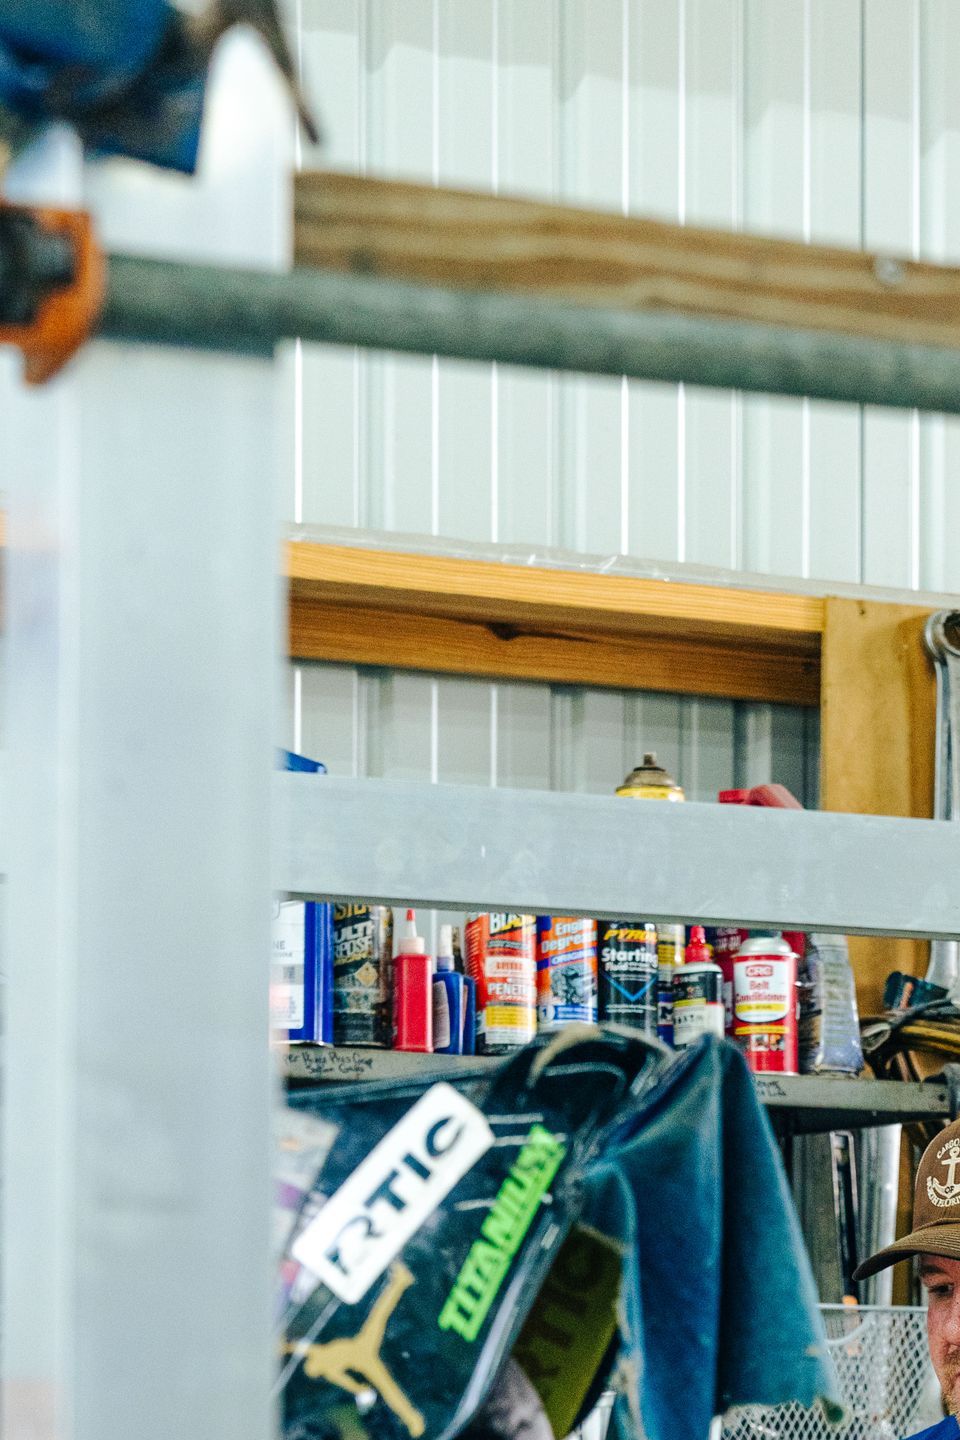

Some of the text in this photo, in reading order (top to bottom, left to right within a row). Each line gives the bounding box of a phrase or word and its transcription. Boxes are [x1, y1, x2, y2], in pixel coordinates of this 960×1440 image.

[602, 947, 659, 968] Starting
[746, 966, 773, 976] CRC
[750, 981, 769, 990] Belt
[736, 992, 787, 1003] Conditioner
[936, 1138, 960, 1159] CARGO
[325, 1113, 467, 1276] RTIC
[944, 1185, 955, 1194] OF
